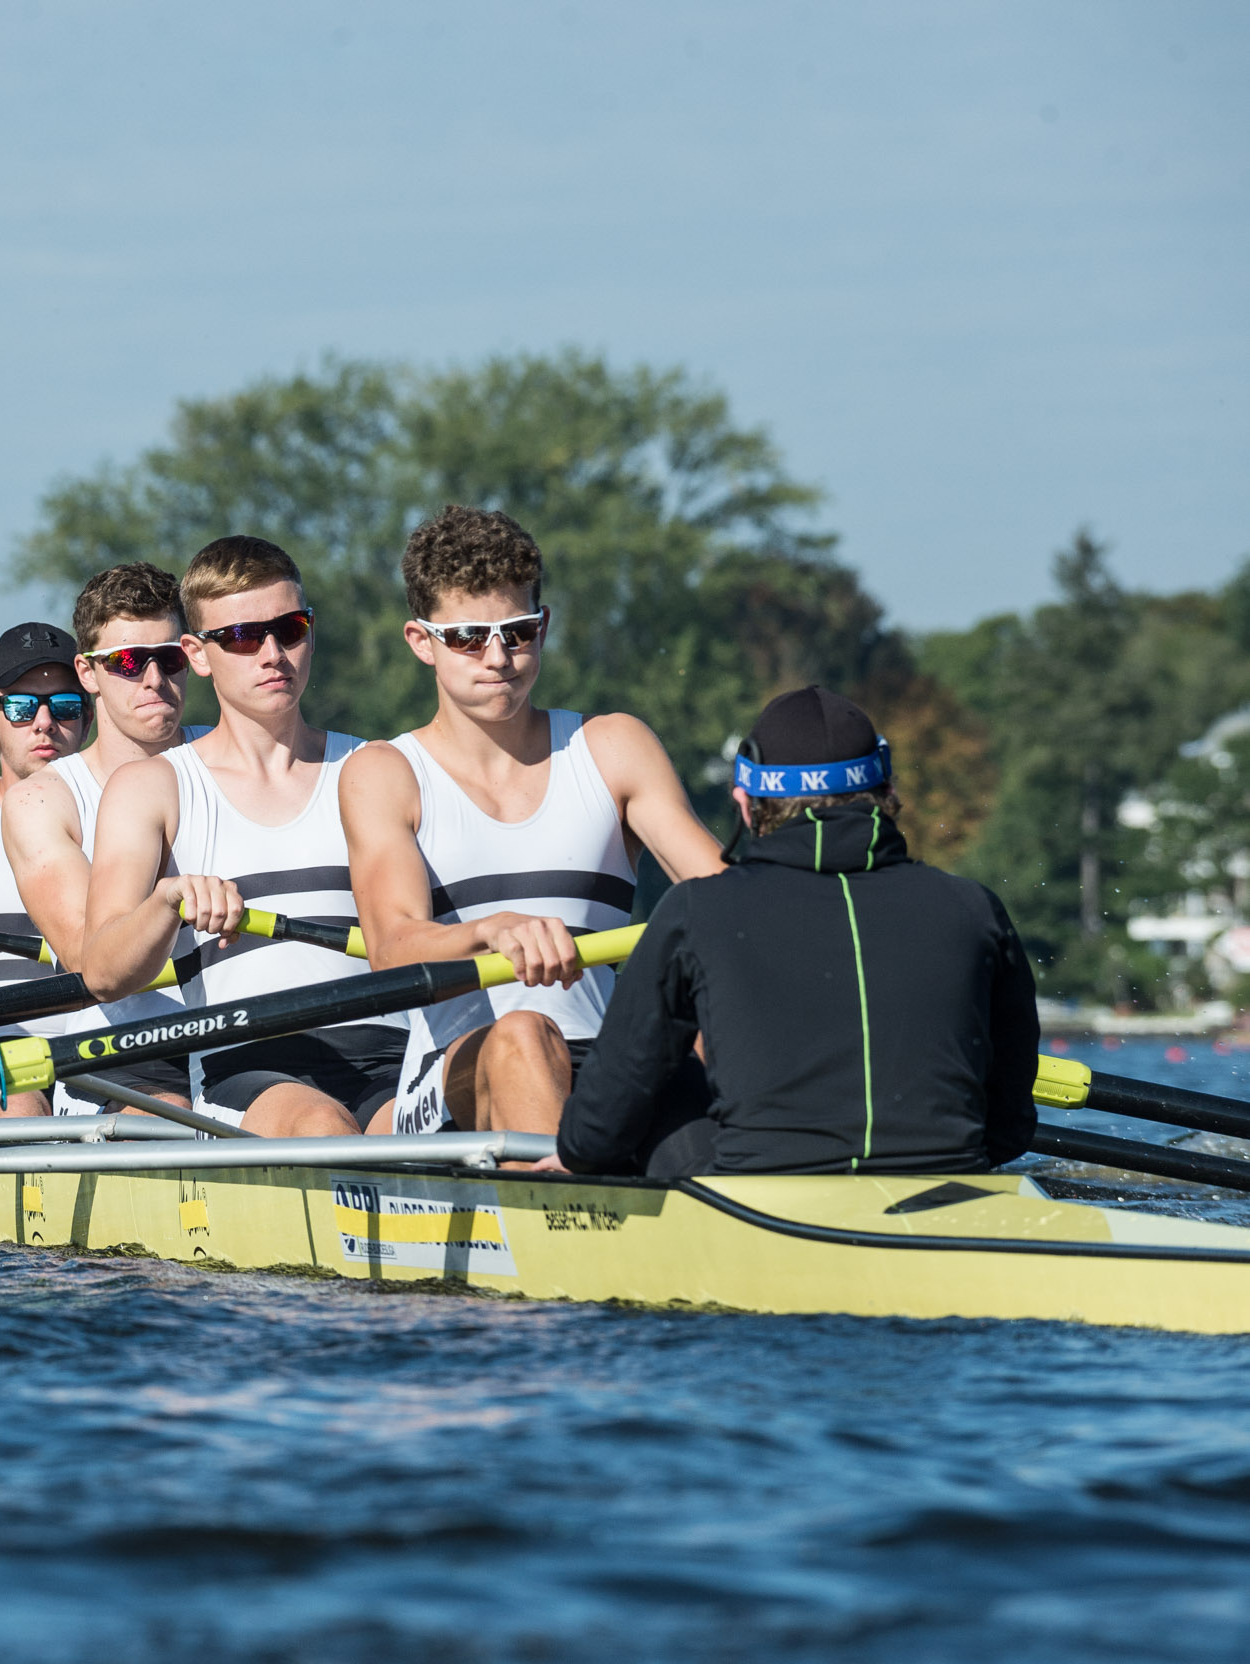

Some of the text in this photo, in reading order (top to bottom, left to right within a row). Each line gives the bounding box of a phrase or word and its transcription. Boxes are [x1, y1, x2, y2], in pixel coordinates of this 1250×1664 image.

[760, 771, 786, 792] NK
[800, 770, 830, 792] NK
[845, 764, 869, 787] NK
[119, 1009, 249, 1050] concept 2
